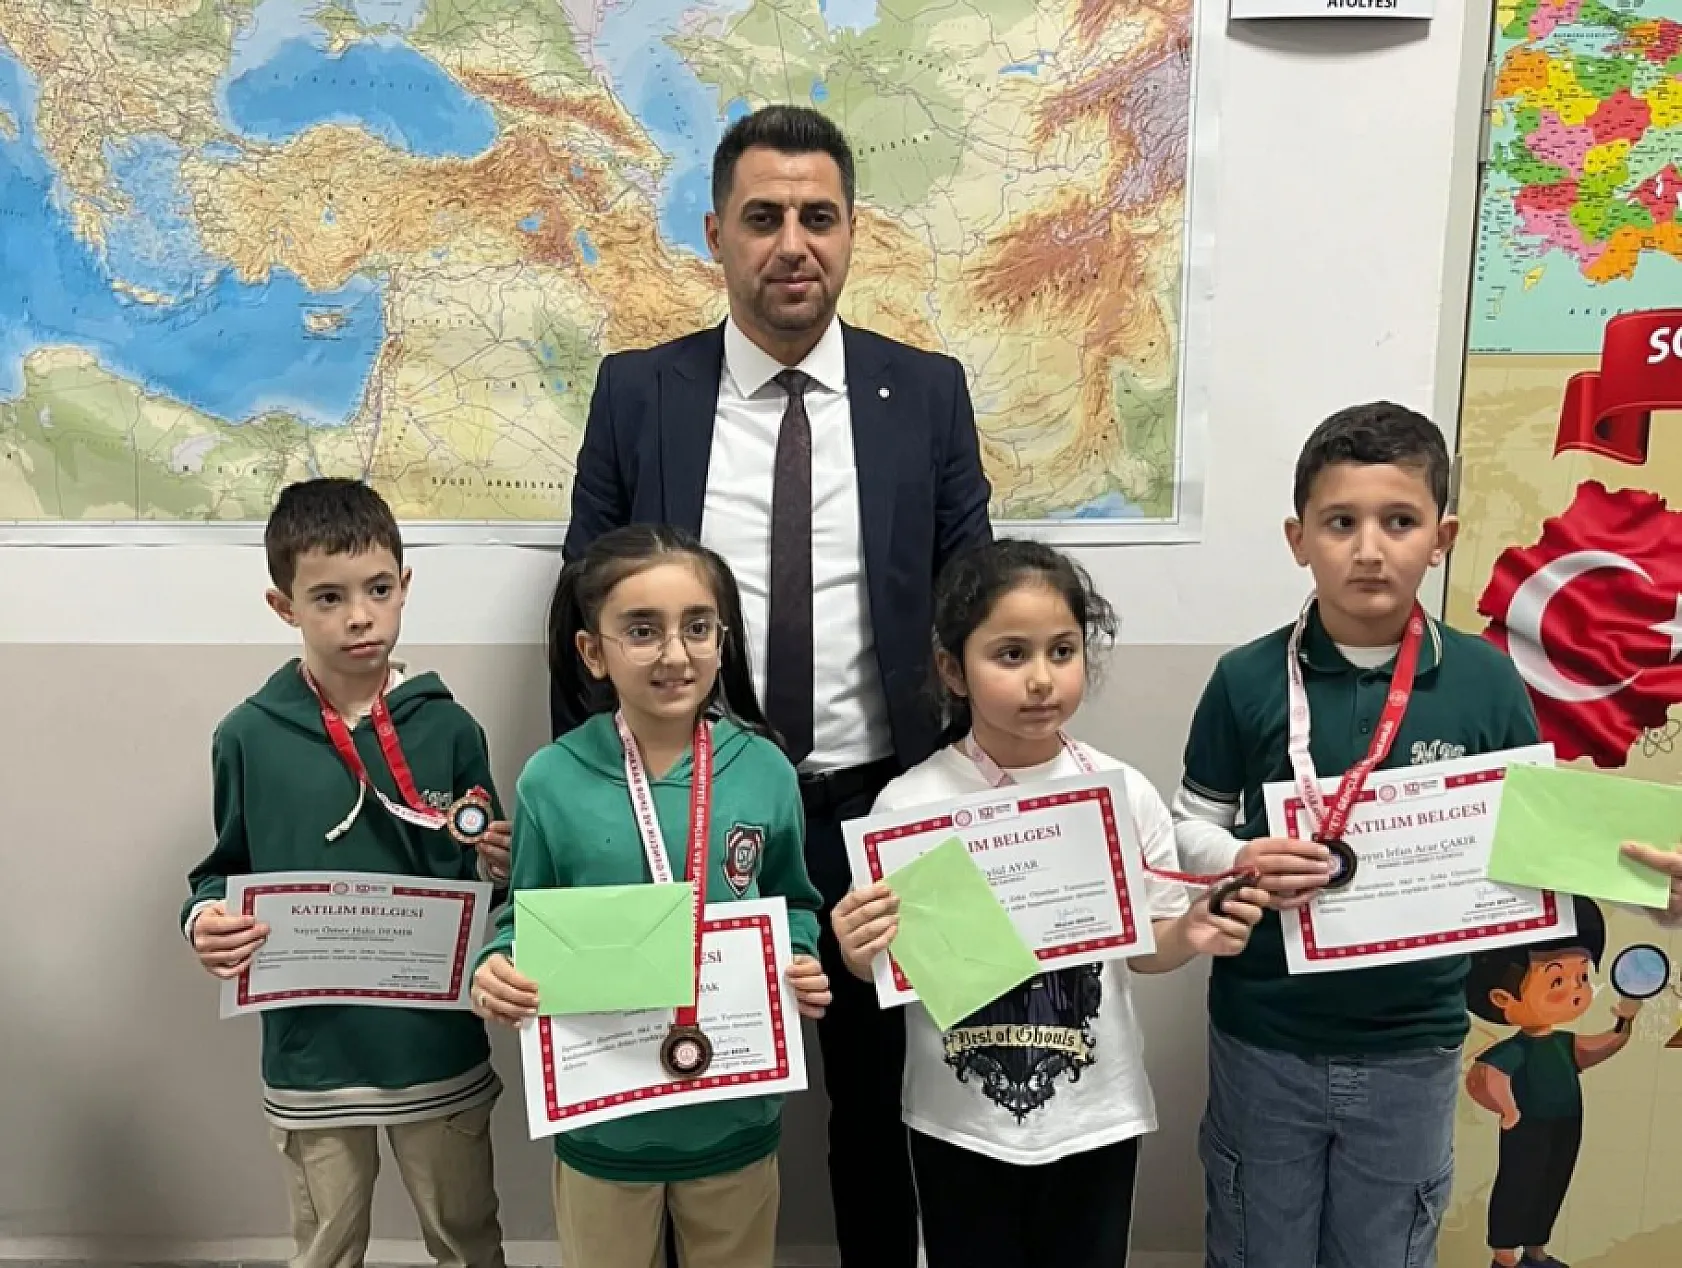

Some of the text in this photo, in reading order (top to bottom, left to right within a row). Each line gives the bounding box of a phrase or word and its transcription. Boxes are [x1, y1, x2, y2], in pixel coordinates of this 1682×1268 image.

[291, 904, 424, 919] KATILIM BELGESİ
[995, 1026, 1012, 1043] of
